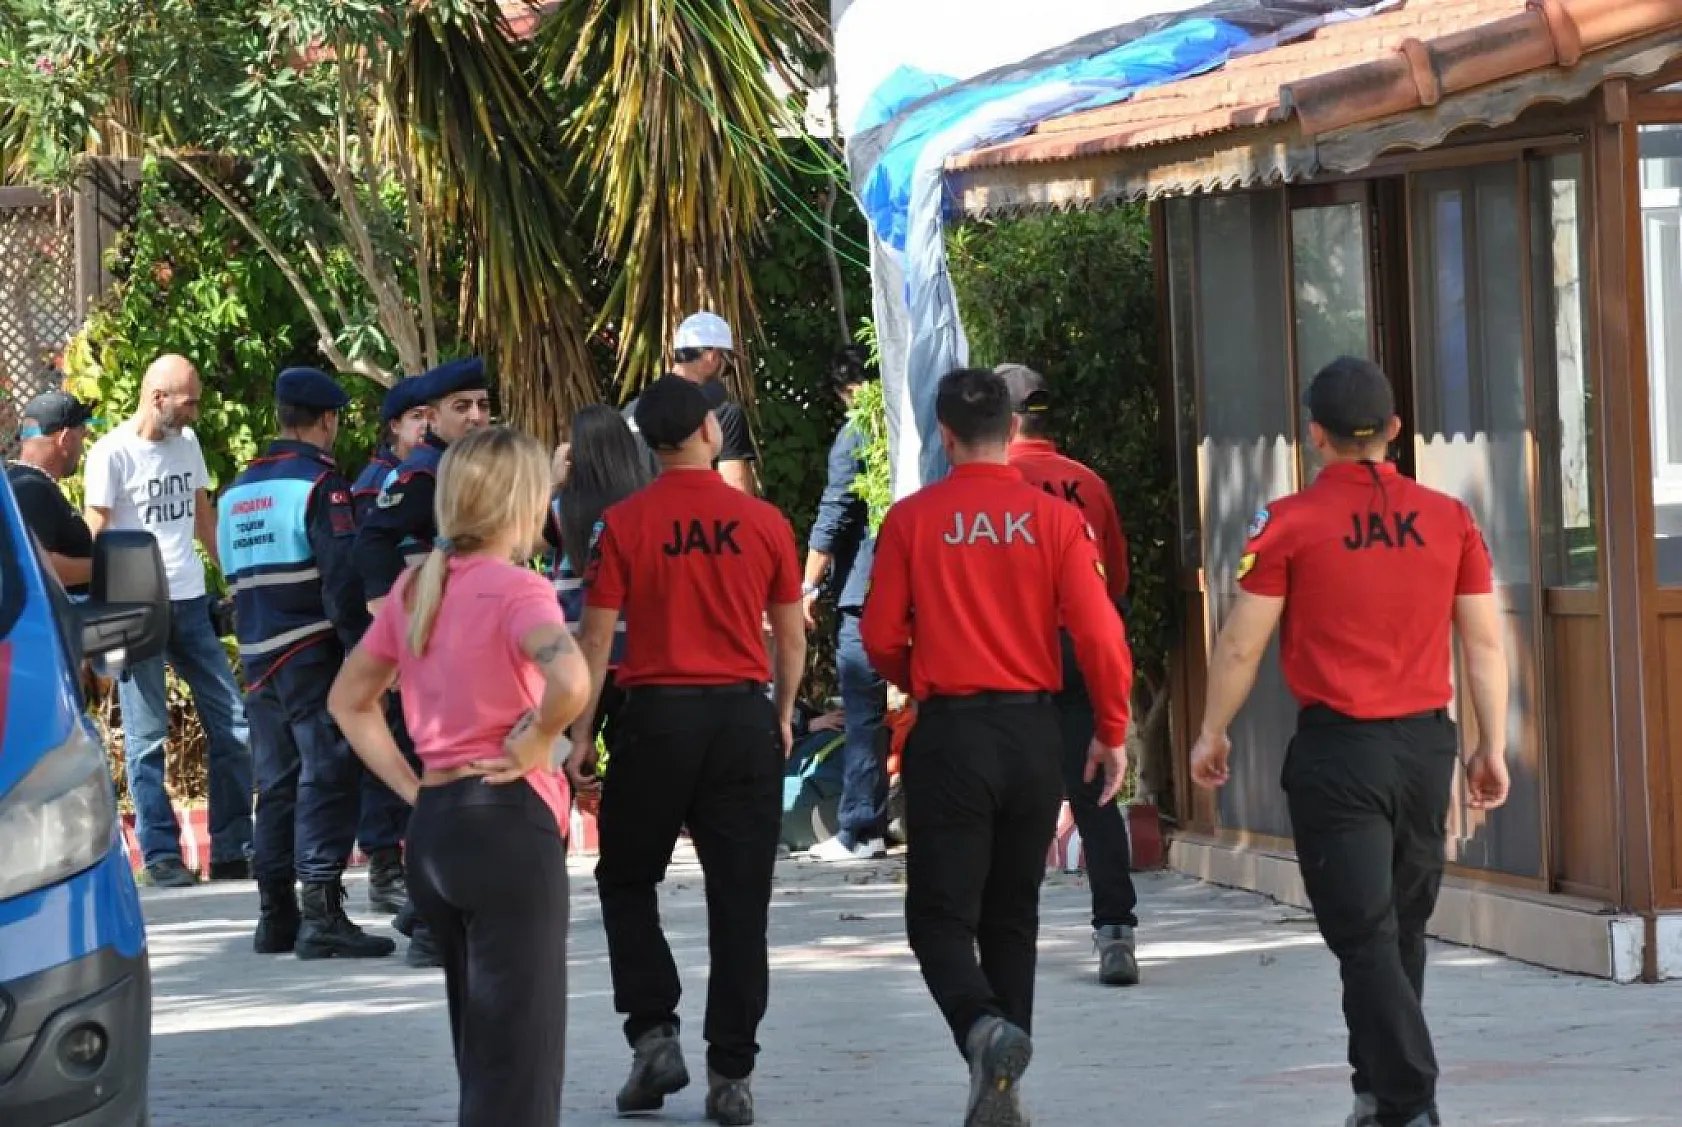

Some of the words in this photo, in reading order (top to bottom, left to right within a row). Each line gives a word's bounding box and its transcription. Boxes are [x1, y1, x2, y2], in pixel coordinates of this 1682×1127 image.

[662, 519, 742, 557] JAK
[943, 511, 1036, 545] JAK
[1343, 510, 1426, 550] JAK
